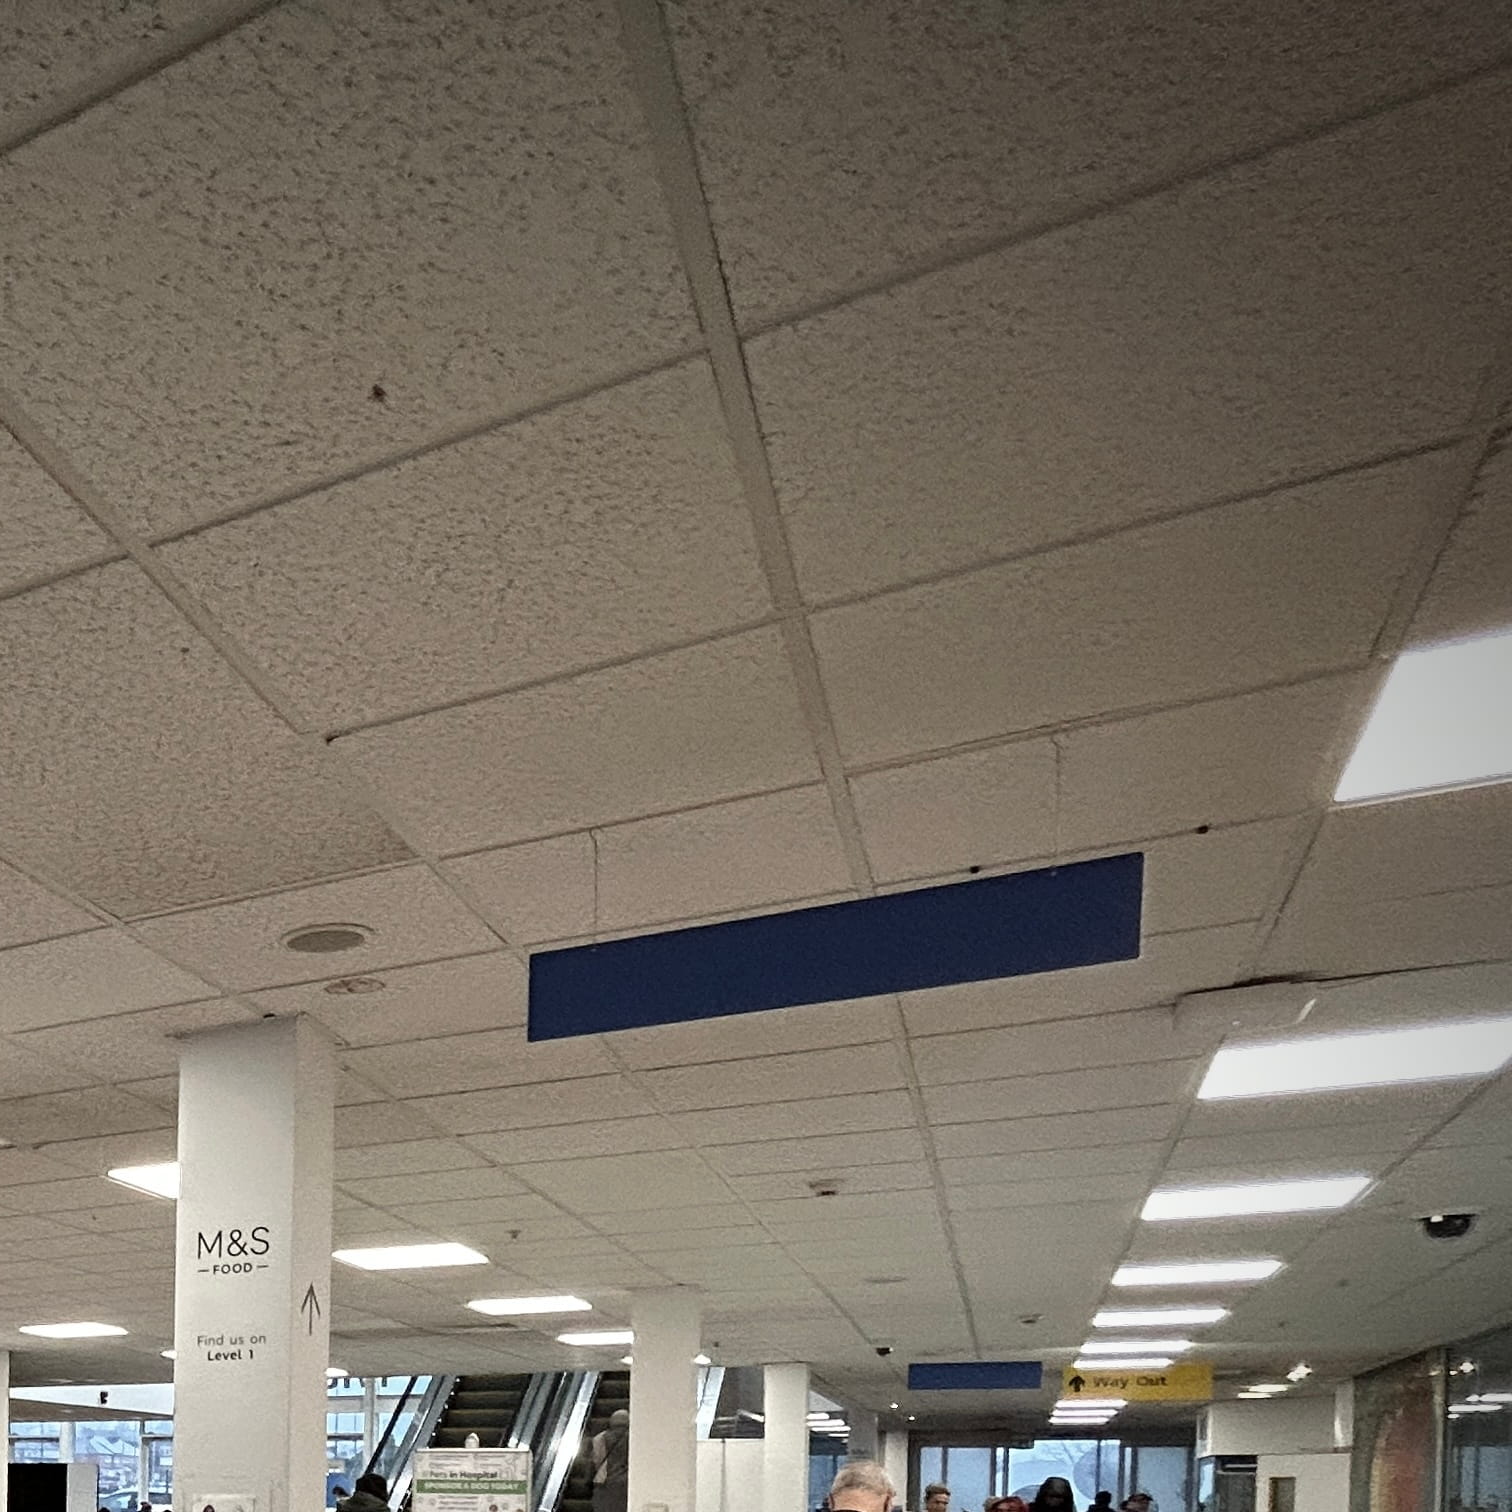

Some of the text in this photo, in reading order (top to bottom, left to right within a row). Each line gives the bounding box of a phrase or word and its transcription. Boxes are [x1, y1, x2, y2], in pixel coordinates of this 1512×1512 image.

[197, 1226, 270, 1259] M&S
[213, 1263, 253, 1274] FOOD
[197, 1334, 266, 1346] Find us on
[207, 1349, 254, 1361] Level 1
[1093, 1375, 1168, 1389] Way Out
